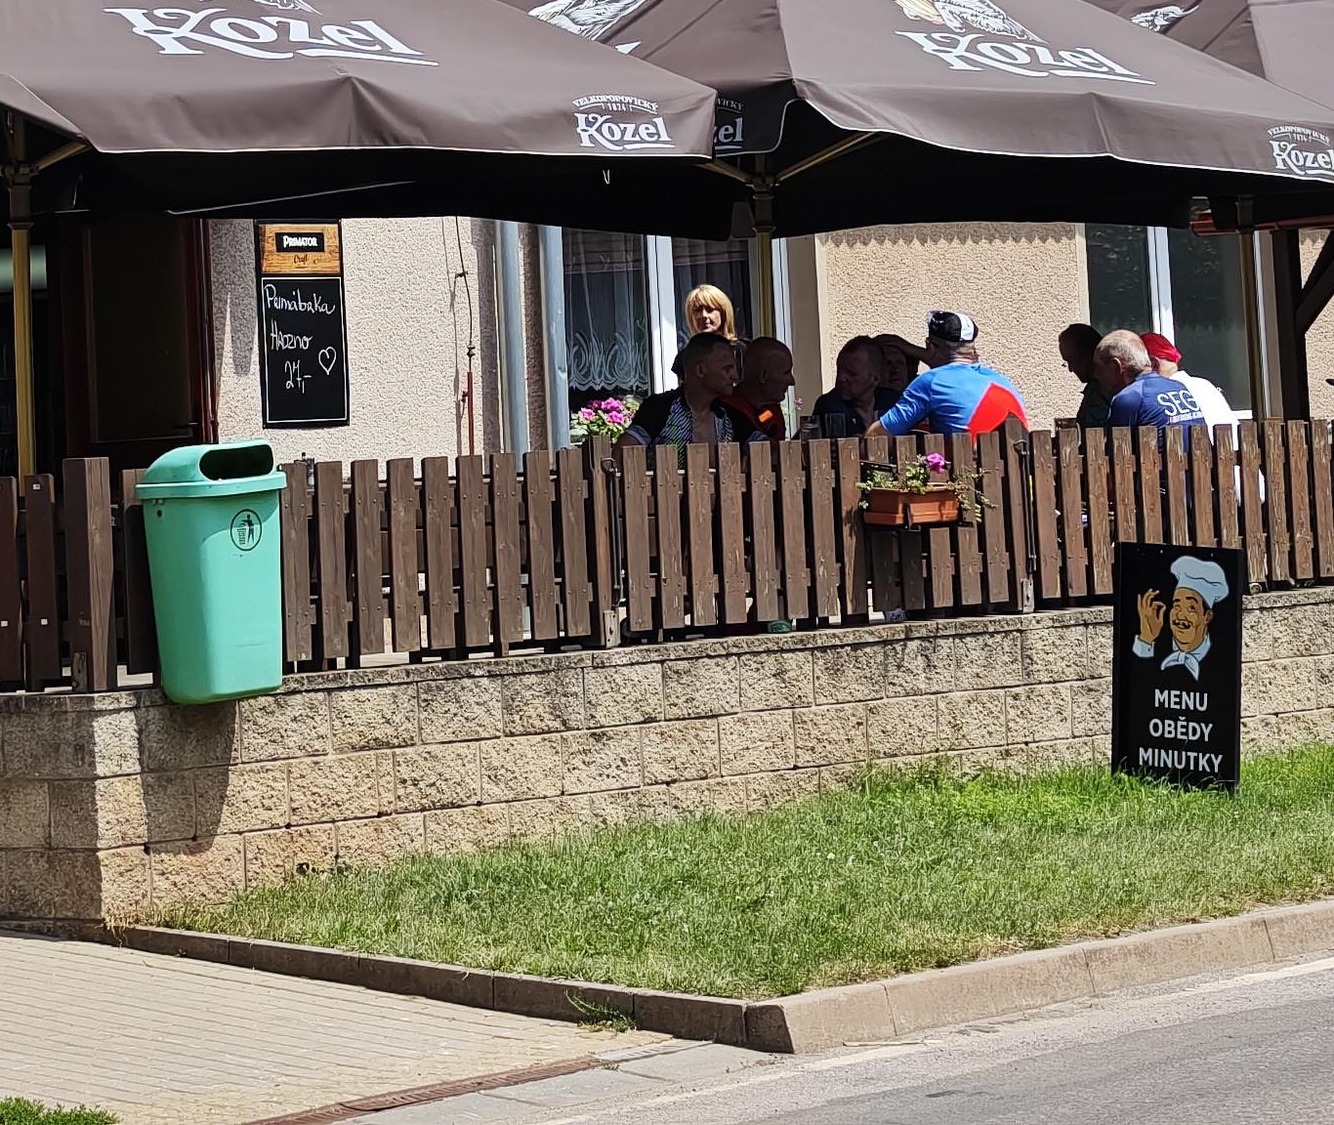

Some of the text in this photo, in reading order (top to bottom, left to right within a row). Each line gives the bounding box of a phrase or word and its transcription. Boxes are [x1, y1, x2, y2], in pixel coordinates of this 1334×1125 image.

[103, 8, 439, 66] Kozel
[894, 31, 1155, 85] Kozel
[574, 113, 676, 151] Kozel
[1154, 688, 1209, 712] MENU
[1148, 716, 1213, 742] OBĚDY
[1138, 747, 1223, 773] MINUTKY
